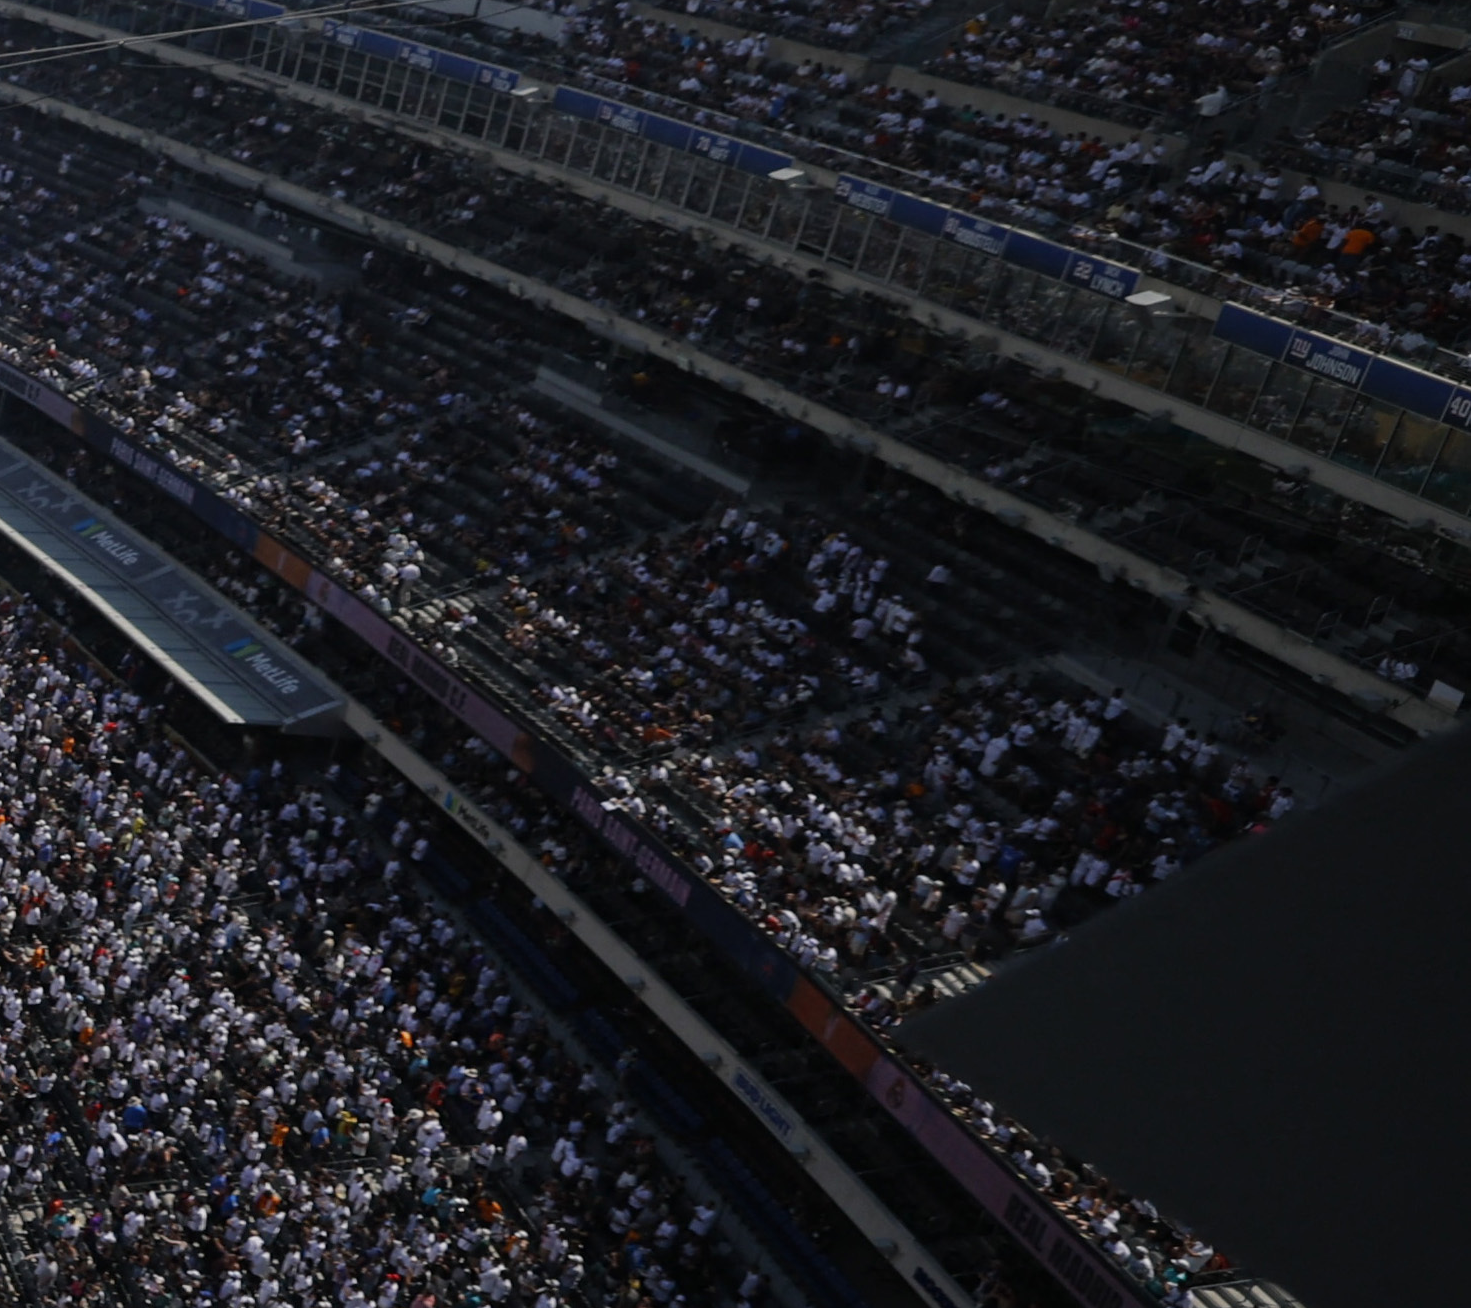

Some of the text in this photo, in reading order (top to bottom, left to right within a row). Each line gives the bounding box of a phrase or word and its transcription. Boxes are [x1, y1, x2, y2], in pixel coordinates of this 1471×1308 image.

[1073, 260, 1093, 280] 22
[1305, 352, 1361, 385] JOHNSON
[1450, 396, 1469, 419] 40
[89, 529, 141, 567] MetLife
[243, 651, 302, 697] MetLife
